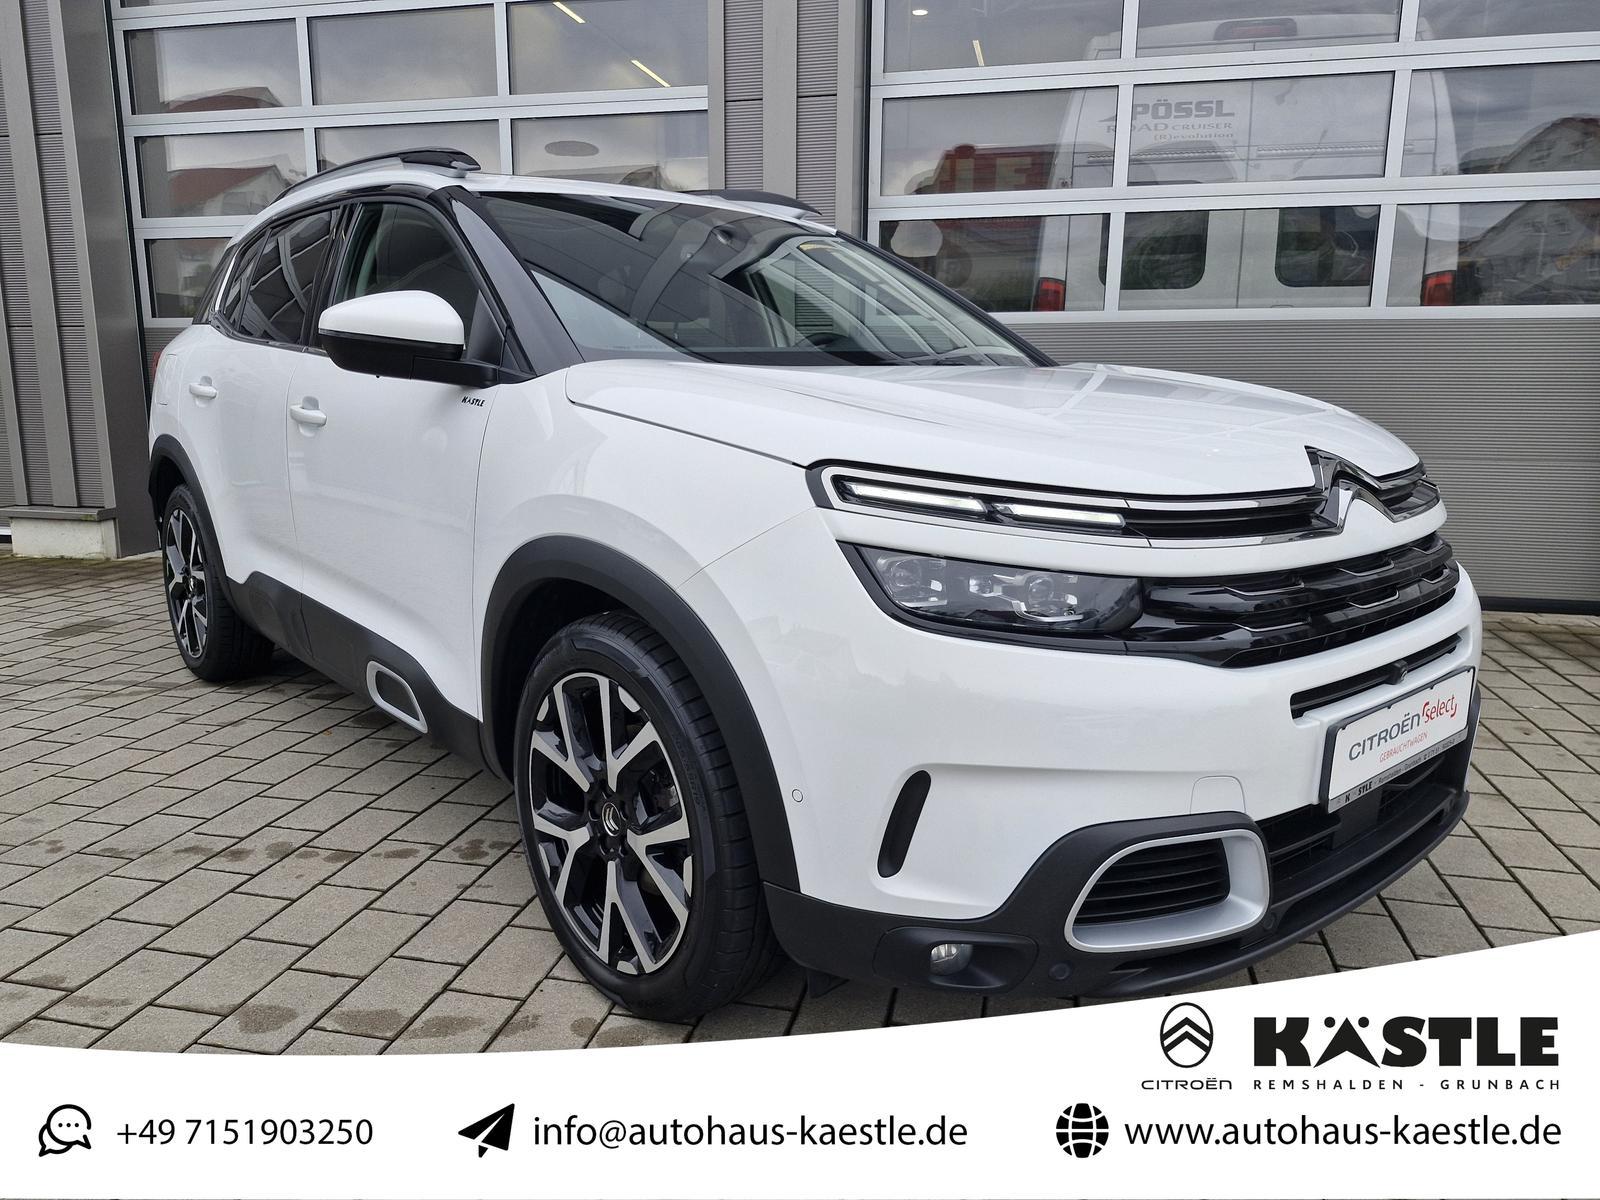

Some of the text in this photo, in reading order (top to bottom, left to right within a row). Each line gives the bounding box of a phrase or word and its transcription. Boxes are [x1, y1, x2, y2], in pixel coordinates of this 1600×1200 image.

[1131, 99, 1235, 121] PÖSSL
[1106, 122, 1233, 134] RAD CRUISER
[1348, 712, 1420, 761] CITROËN
